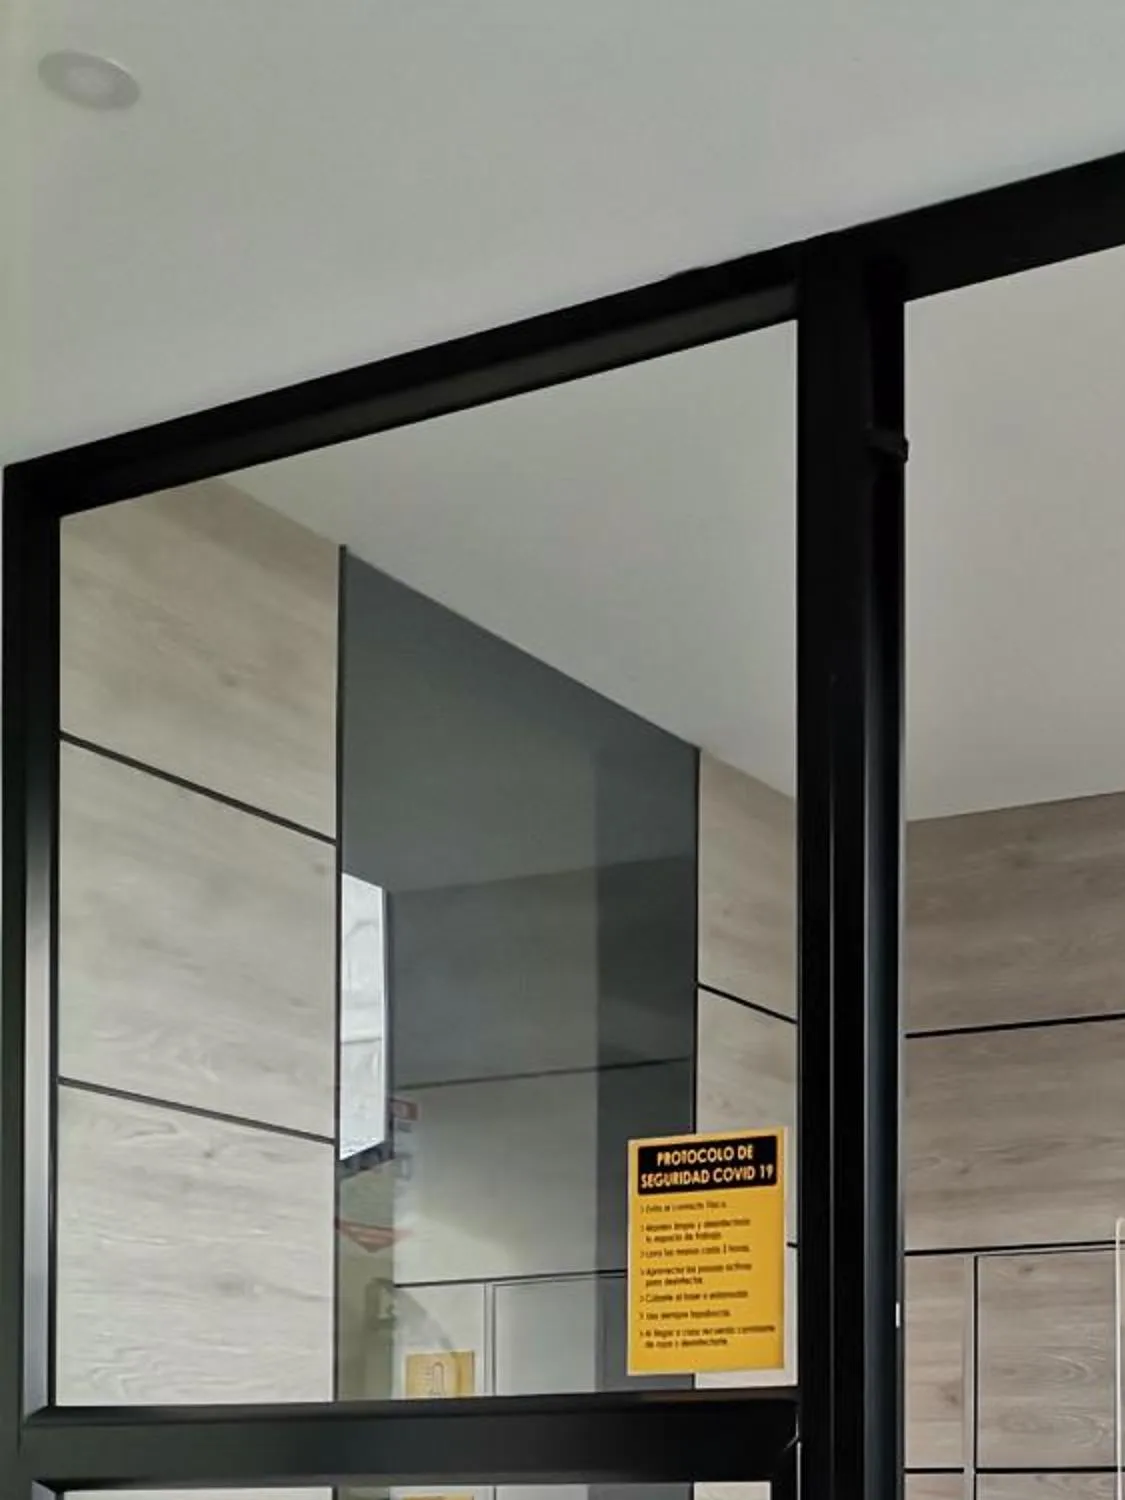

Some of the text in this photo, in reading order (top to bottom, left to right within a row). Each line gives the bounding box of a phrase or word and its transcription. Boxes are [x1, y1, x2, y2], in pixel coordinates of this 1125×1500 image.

[657, 1144, 754, 1166] PROTOCOLO DE
[641, 1164, 774, 1188] SEGURIDAD COVID 19
